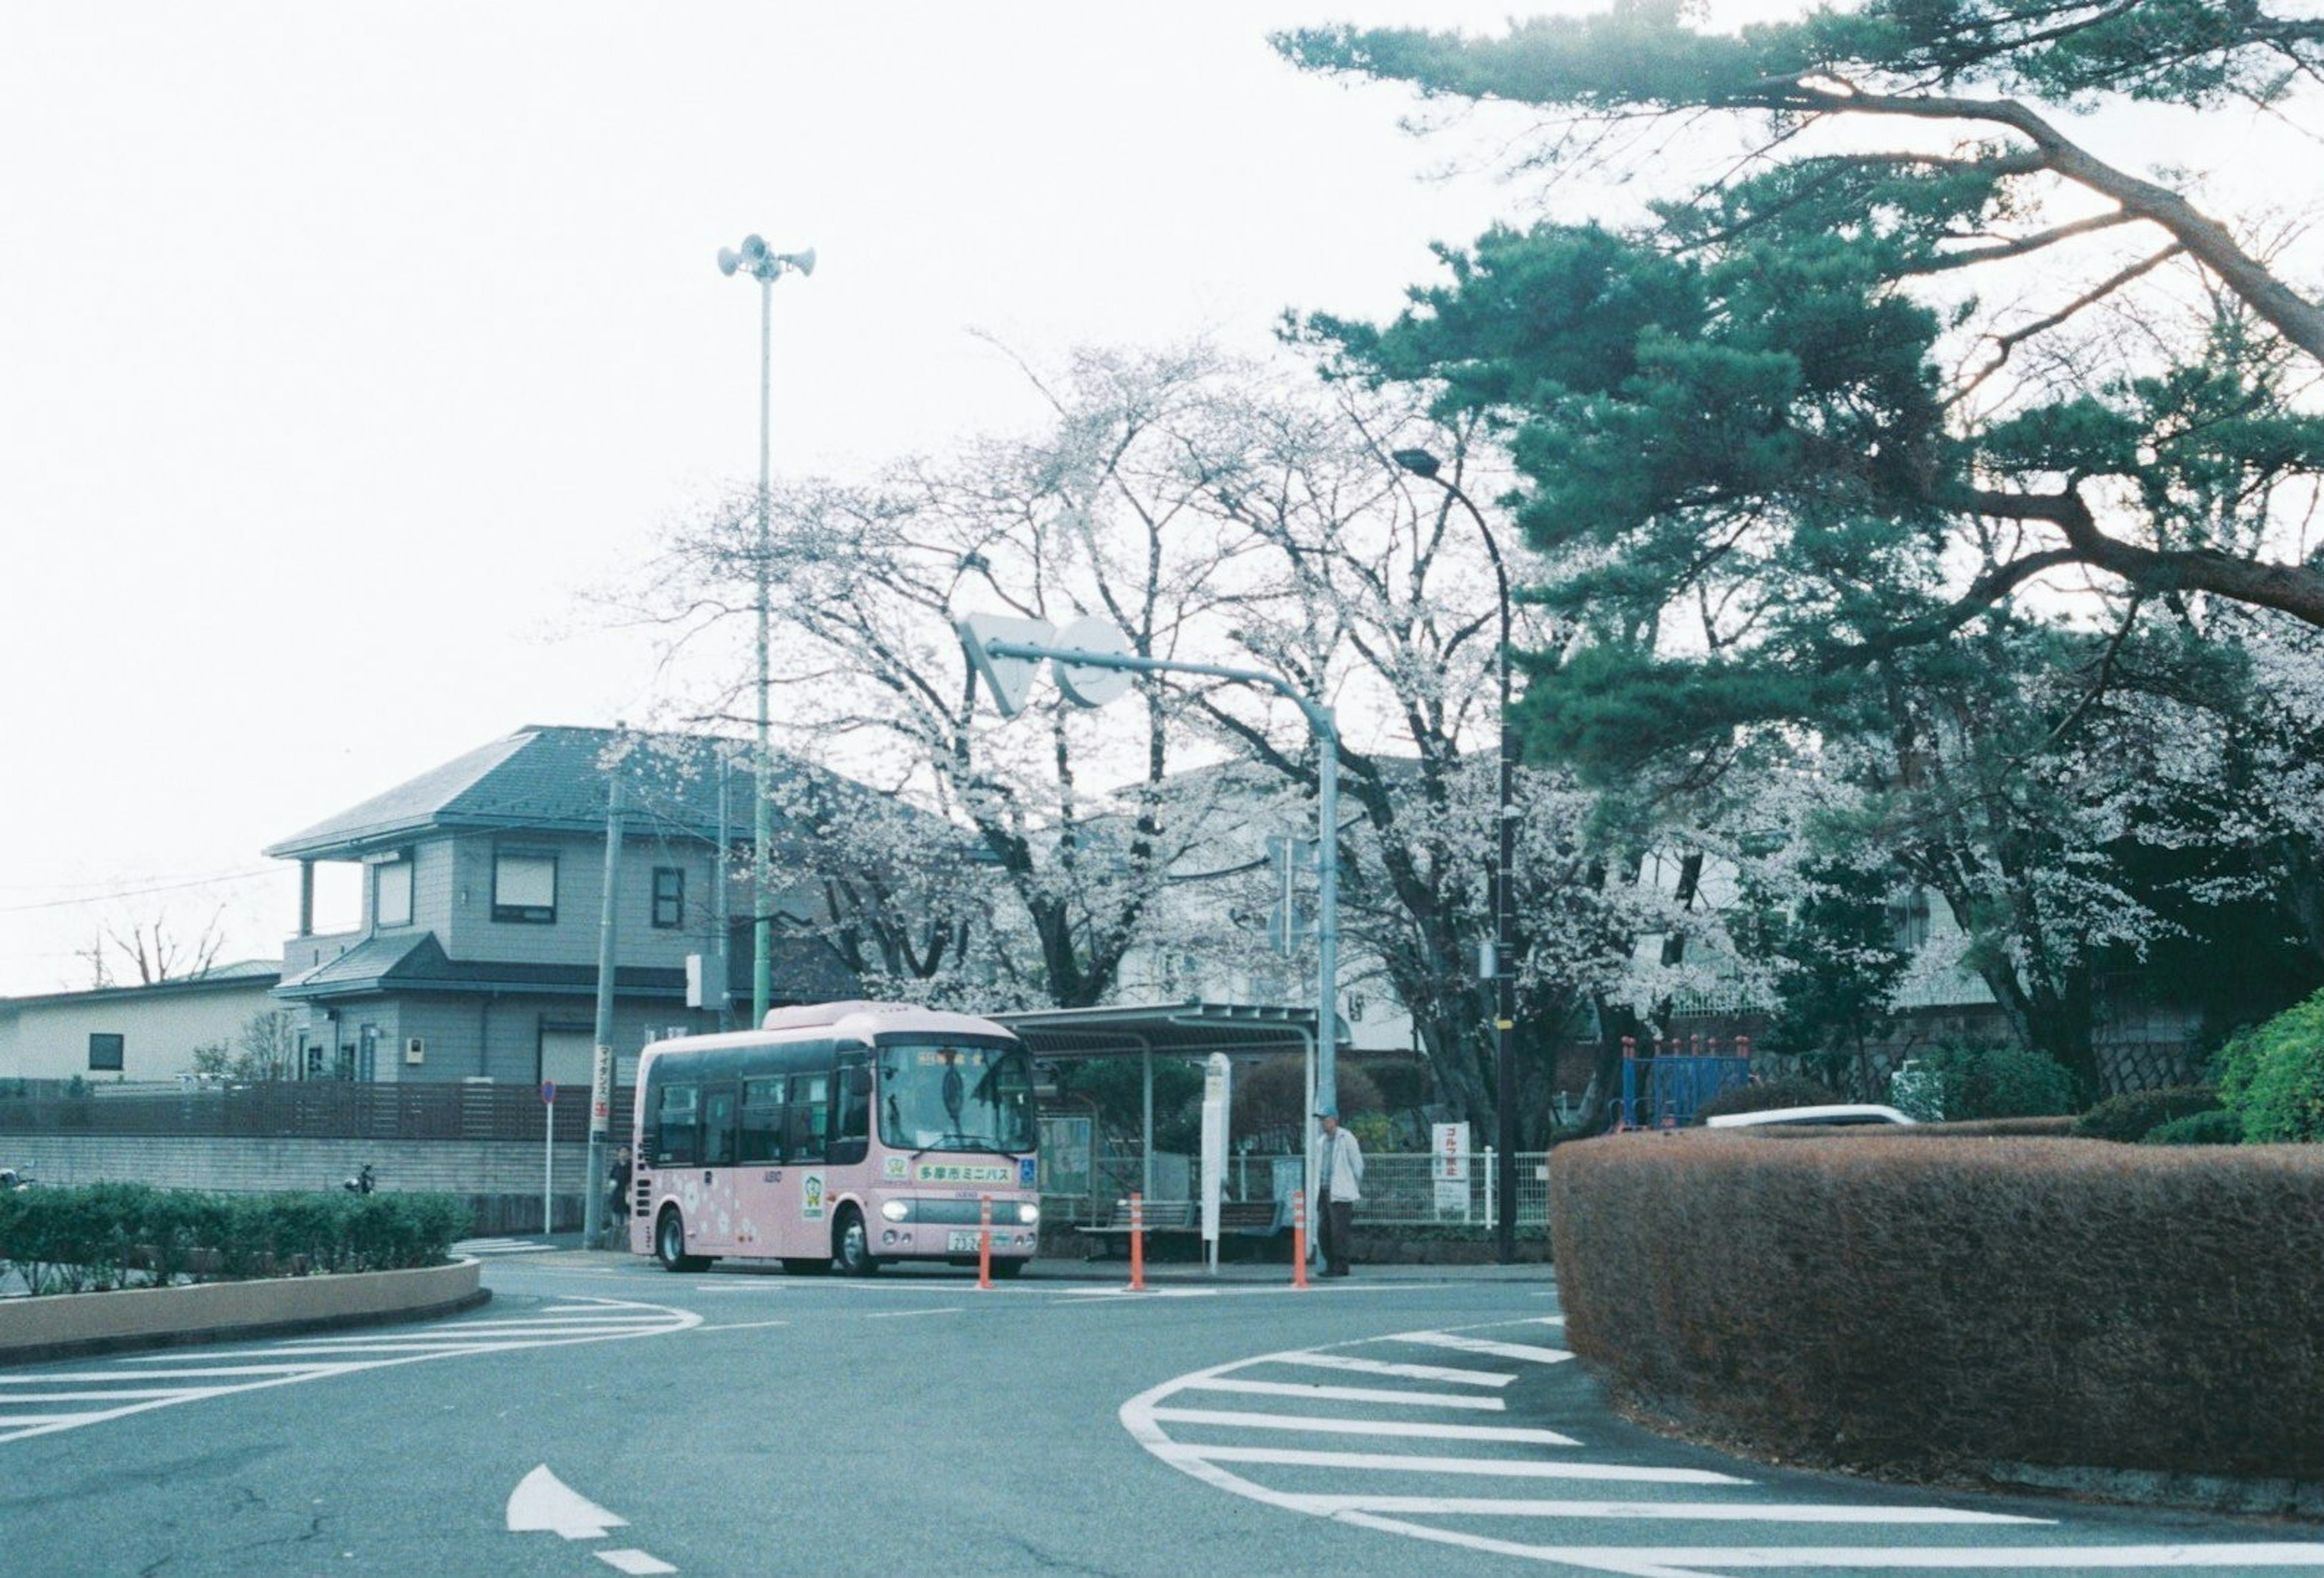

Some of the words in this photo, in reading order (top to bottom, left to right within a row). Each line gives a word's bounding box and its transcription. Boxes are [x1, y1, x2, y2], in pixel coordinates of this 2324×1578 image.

[921, 1166, 1009, 1180] 多摩市ミニバス
